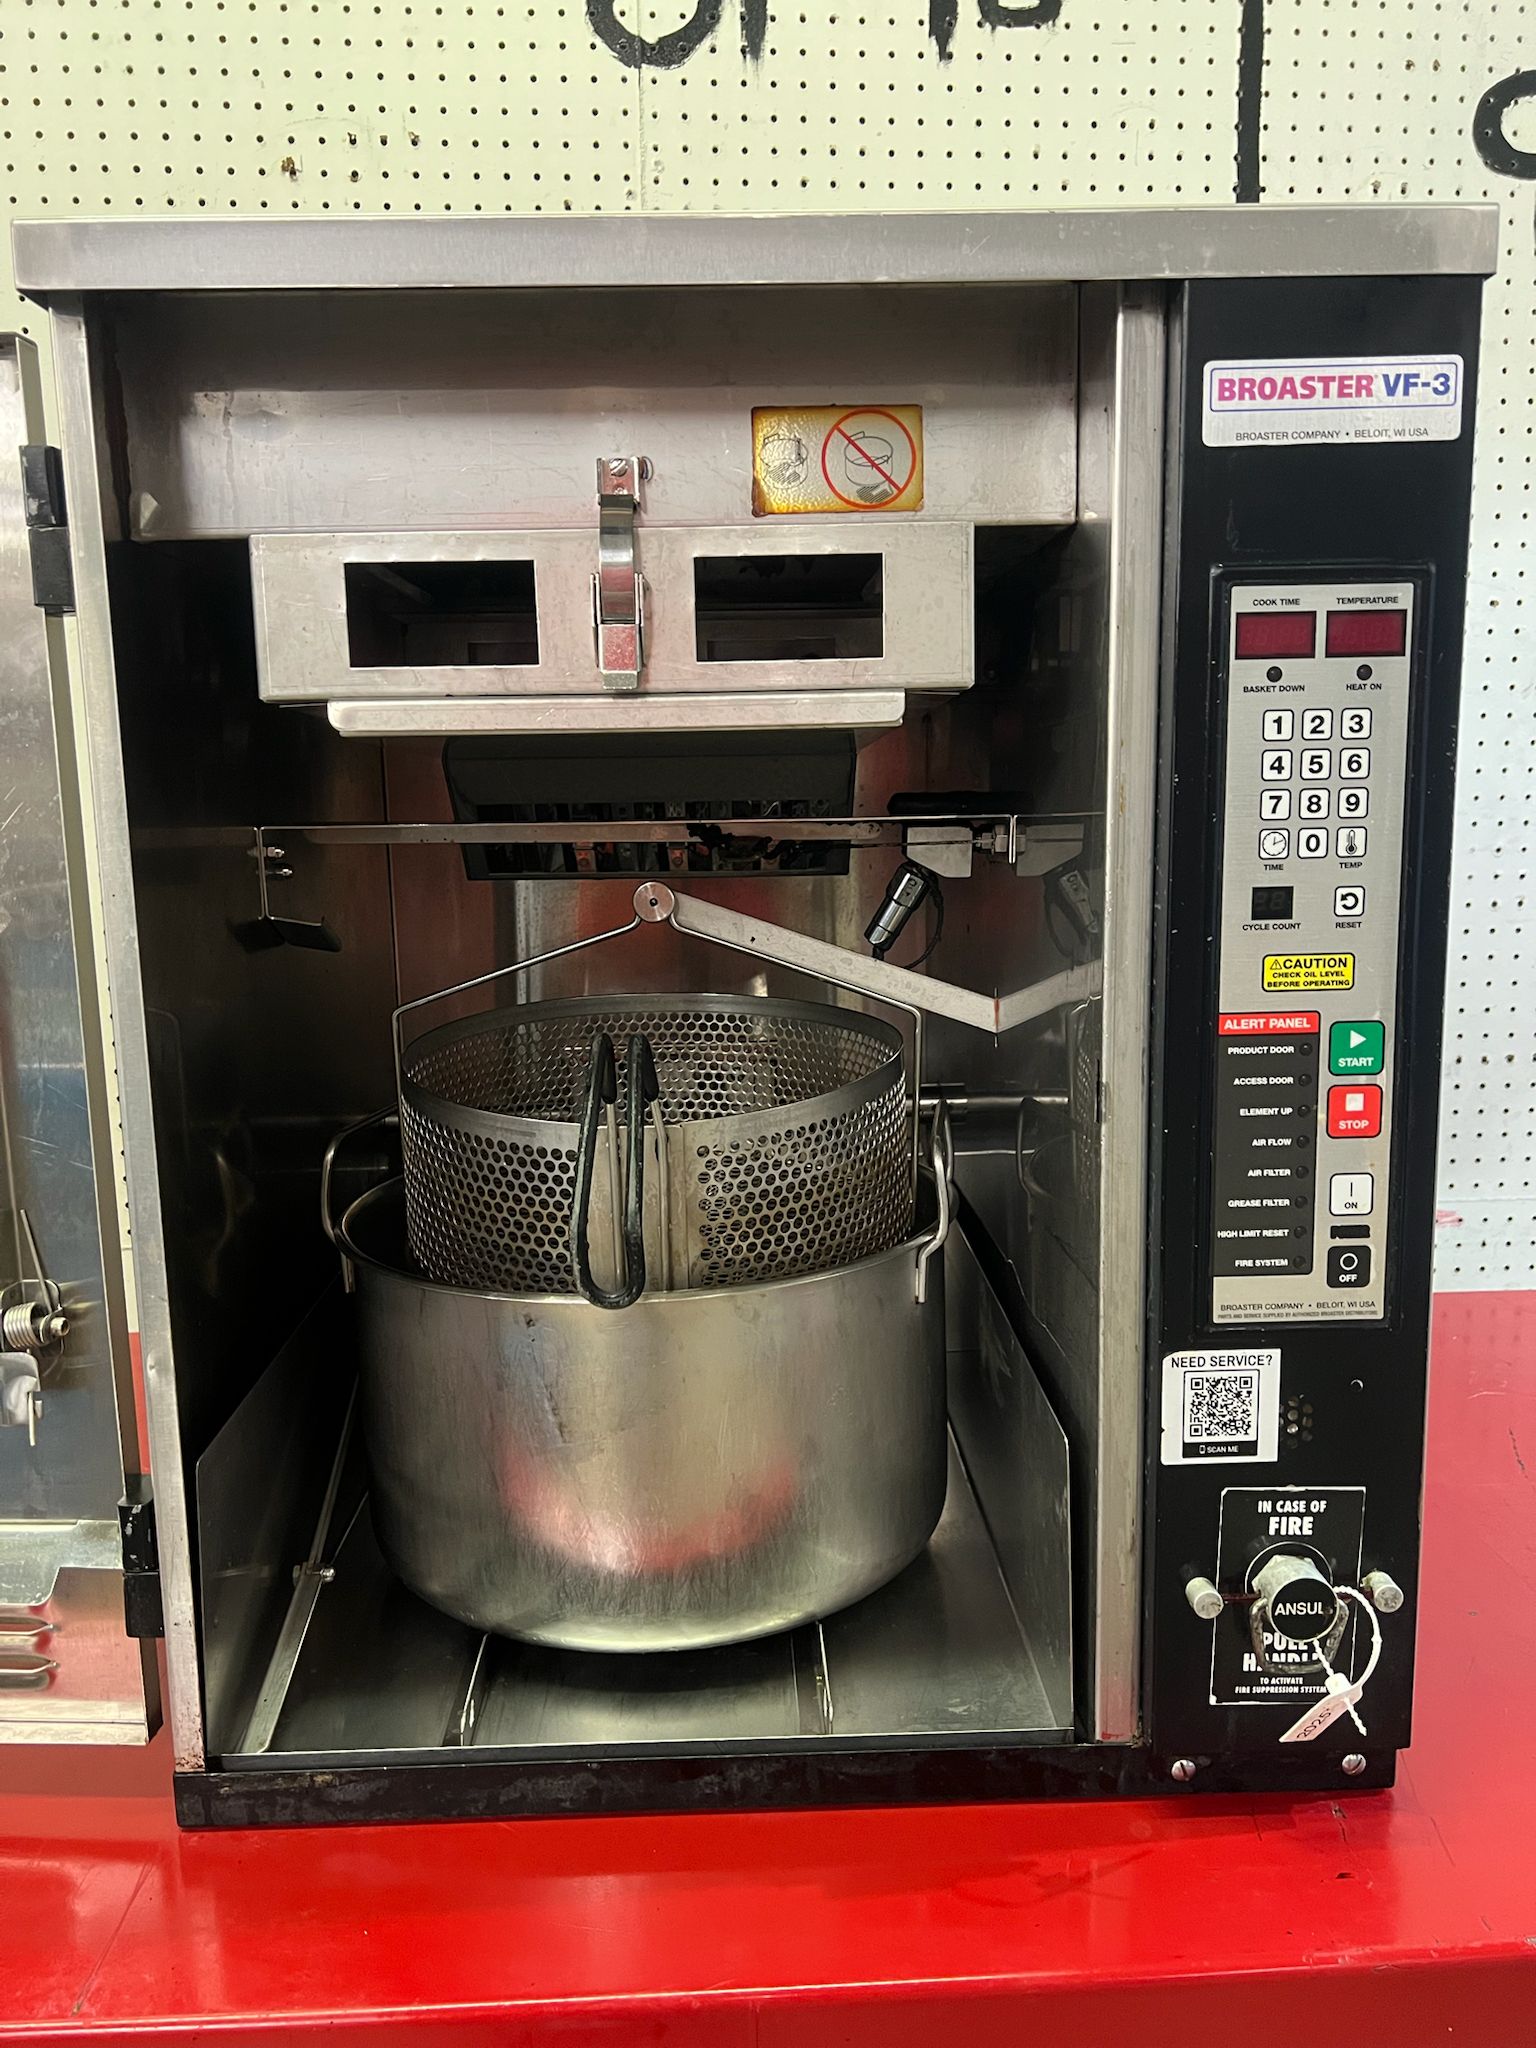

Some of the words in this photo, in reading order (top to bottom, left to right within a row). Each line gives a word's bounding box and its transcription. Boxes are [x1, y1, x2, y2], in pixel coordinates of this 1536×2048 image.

[1218, 375, 1373, 401] BROASTER
[1382, 373, 1450, 397] VF-3
[1236, 431, 1288, 441] BROASTER
[1291, 430, 1341, 440] COMPANY
[1354, 429, 1391, 439] BELOIT,
[1394, 429, 1405, 437] WI
[1408, 428, 1429, 437] USA
[1280, 598, 1300, 606] TIME
[1336, 596, 1399, 605] TEMPERATURE
[1272, 715, 1282, 735] 1
[1310, 715, 1325, 734] 2
[1348, 714, 1364, 733] 3
[1269, 755, 1284, 774] 4
[1308, 755, 1323, 774] 5
[1347, 753, 1362, 772] 6
[1269, 795, 1283, 814] 7
[1306, 794, 1322, 813] 8
[1345, 793, 1360, 812] 9
[1305, 834, 1320, 852] 0
[1264, 863, 1284, 871] TIME
[1242, 923, 1270, 931] CYCLE
[1272, 922, 1301, 930] COUNT
[1335, 921, 1362, 929] RESET
[1283, 957, 1347, 969] CAUTION
[1267, 980, 1300, 988] BEFORE
[1303, 979, 1350, 987] OPERATING
[1224, 1019, 1265, 1030] ALERT
[1269, 1018, 1311, 1029] PANEL
[1228, 1047, 1268, 1055] PRODUCT
[1338, 1057, 1374, 1067] START
[1233, 1077, 1267, 1085] ACCESS
[1240, 1108, 1279, 1116] ELEMENT
[1281, 1107, 1293, 1115] UP
[1339, 1120, 1369, 1130] STOP
[1251, 1139, 1267, 1147] AIR
[1268, 1138, 1292, 1146] FLOW
[1248, 1169, 1263, 1177] AIR
[1264, 1168, 1291, 1176] FILTER
[1228, 1199, 1261, 1207] GREASE
[1263, 1198, 1290, 1206] FILTER
[1217, 1230, 1238, 1238] HIGH
[1239, 1229, 1262, 1237] LIMIT
[1264, 1229, 1289, 1237] RESET
[1235, 1259, 1253, 1267] FIRE
[1255, 1259, 1288, 1267] SYSTEM
[1339, 1274, 1357, 1283] OFF
[1220, 1303, 1262, 1311] BROASTER
[1264, 1302, 1304, 1310] COMPANY
[1171, 1356, 1206, 1368] NEED
[1210, 1354, 1273, 1367] SERVICE?
[1207, 1446, 1227, 1454] SCAN
[1228, 1445, 1239, 1453] ME
[1257, 1501, 1272, 1513] IN
[1276, 1500, 1306, 1513] CASE
[1309, 1500, 1327, 1513] OF
[1268, 1516, 1314, 1536] FIRE
[1275, 1602, 1324, 1615] ANSUL
[1260, 1677, 1269, 1685] TO
[1270, 1677, 1303, 1685] ACTIVATE
[1235, 1686, 1250, 1694] FIRE
[1252, 1686, 1299, 1694] SUPPRESSION
[1300, 1685, 1328, 1693] SYSTEM
